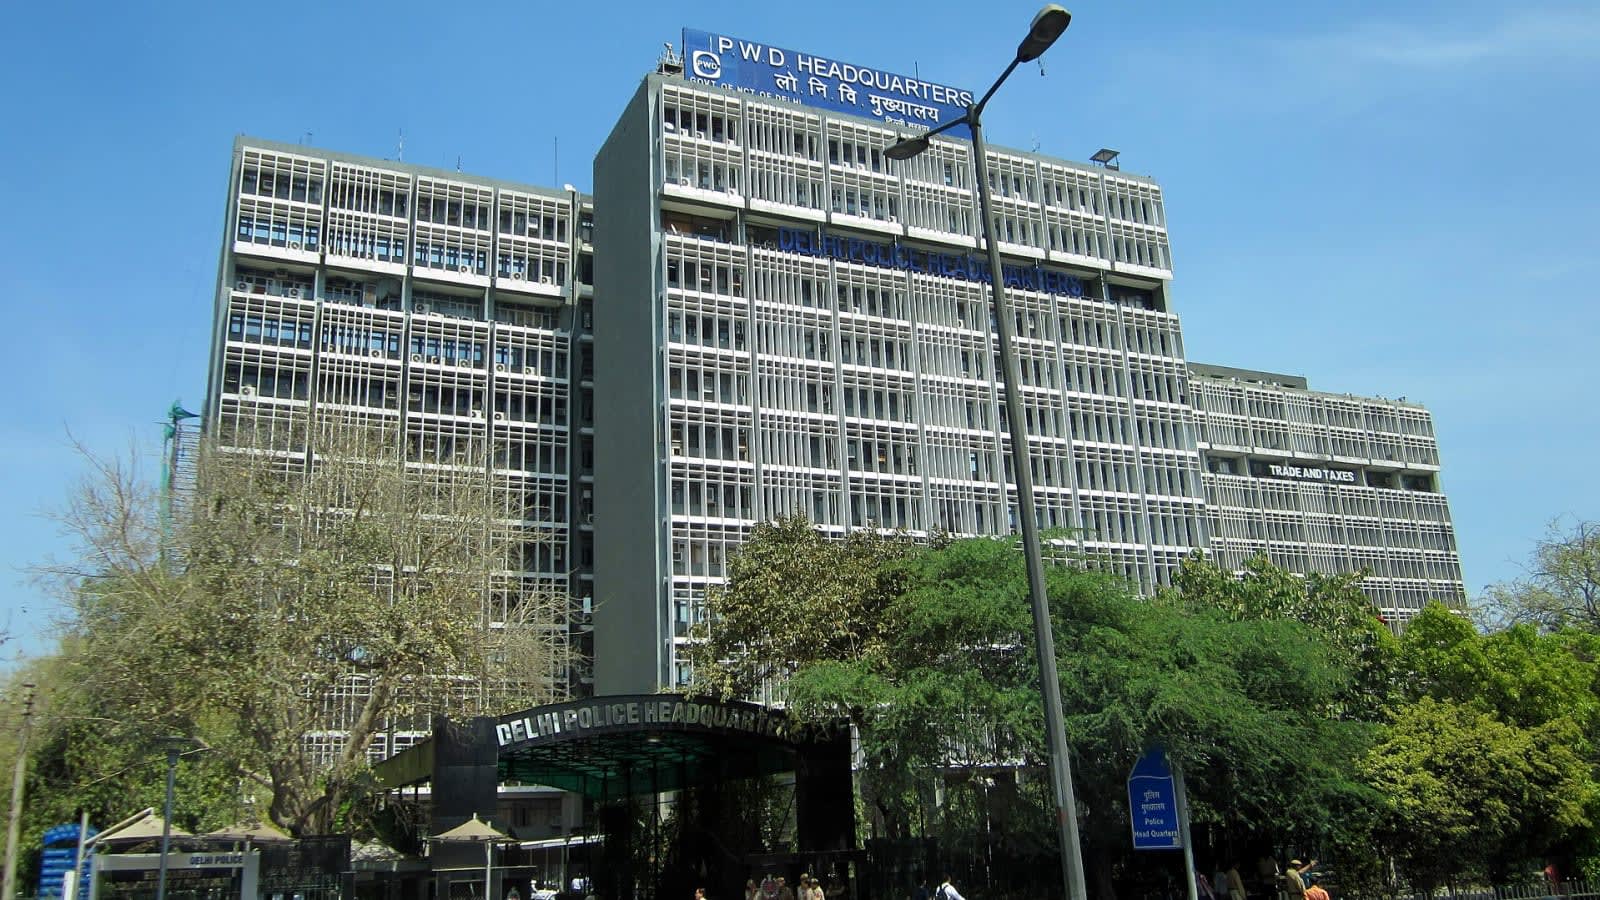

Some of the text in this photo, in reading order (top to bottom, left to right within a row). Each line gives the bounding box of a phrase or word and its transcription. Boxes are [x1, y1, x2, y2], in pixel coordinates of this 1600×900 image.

[697, 59, 718, 70] PWD
[798, 53, 973, 107] HEADQUARTERS
[869, 94, 939, 122] मुख्यालय
[779, 226, 846, 259] DELHI
[849, 237, 923, 271] POLICE
[1269, 465, 1355, 482] TRADE AND TAXES
[495, 711, 561, 747] DELHI
[563, 702, 640, 732] POLICE
[1145, 818, 1164, 826] Police
[1135, 830, 1178, 838] Head Quarters
[190, 855, 243, 865] DELHI POLICE
